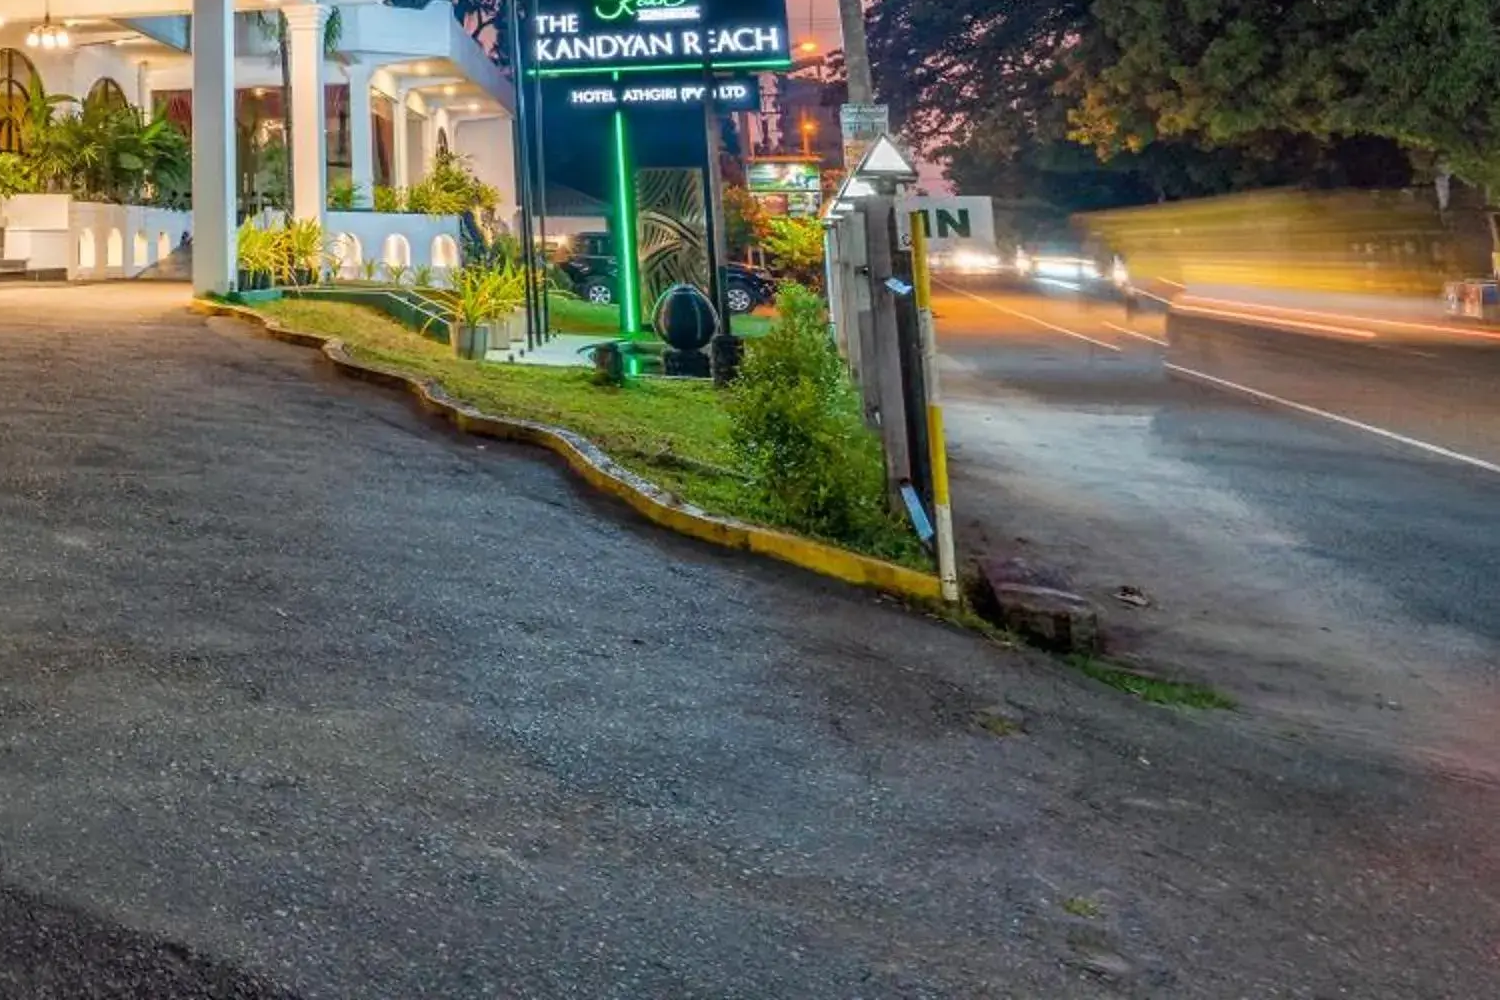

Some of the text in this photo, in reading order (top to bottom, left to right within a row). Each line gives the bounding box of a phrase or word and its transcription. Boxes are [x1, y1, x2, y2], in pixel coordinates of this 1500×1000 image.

[537, 15, 579, 34] THE
[537, 35, 673, 61] KANDYAN
[572, 85, 747, 103] HOTEL ATHGIRI (PV) LTD
